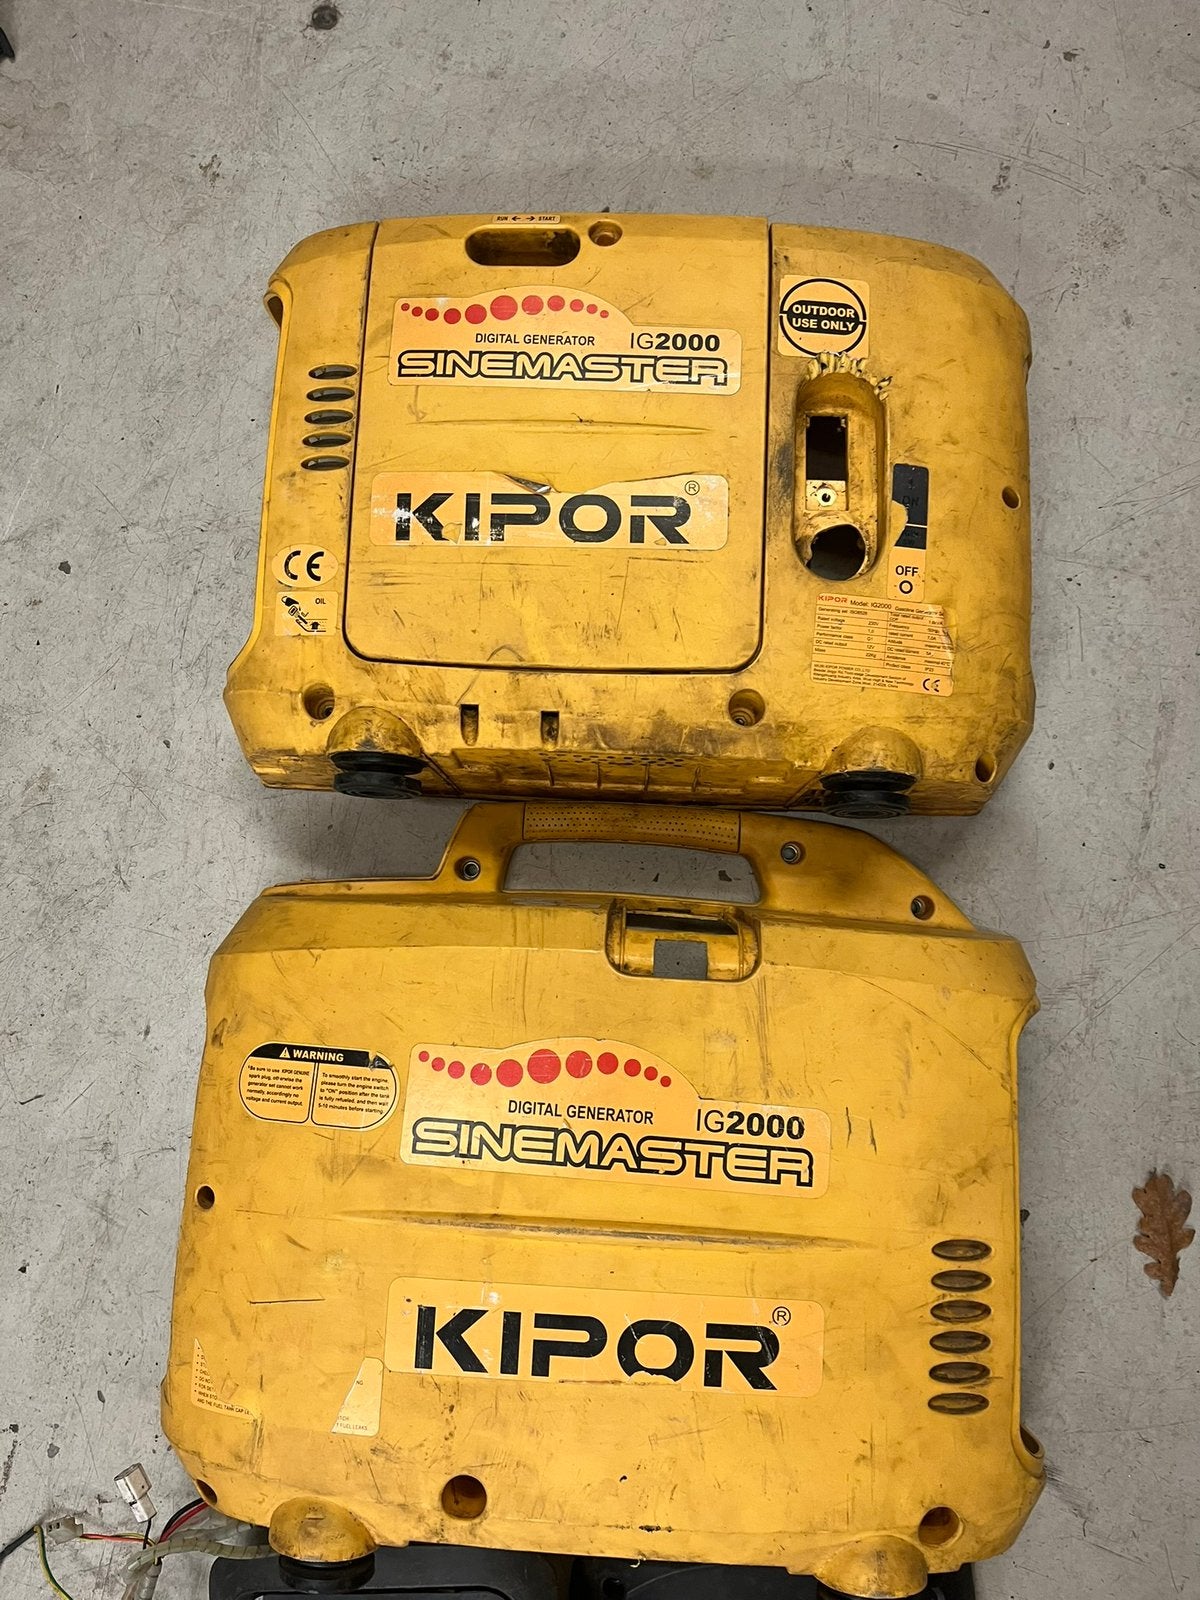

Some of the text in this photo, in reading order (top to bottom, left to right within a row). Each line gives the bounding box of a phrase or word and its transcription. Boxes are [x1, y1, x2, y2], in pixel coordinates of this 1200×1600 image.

[792, 304, 855, 318] OUTDOOR
[792, 318, 855, 331] USE ONLY
[475, 333, 595, 346] DIGITAL GENERATOR
[631, 332, 720, 350] IG2000
[398, 350, 728, 386] SINEMASTER
[395, 493, 691, 545] KIPOR
[284, 550, 324, 582] CE
[895, 565, 918, 576] OFF
[293, 1049, 344, 1062] WARNING
[508, 1100, 654, 1125] DIGITAL GENERATOR
[696, 1108, 805, 1140] IG2000
[411, 1116, 814, 1187] SINEMASTER
[414, 1305, 780, 1391] KIPOR
